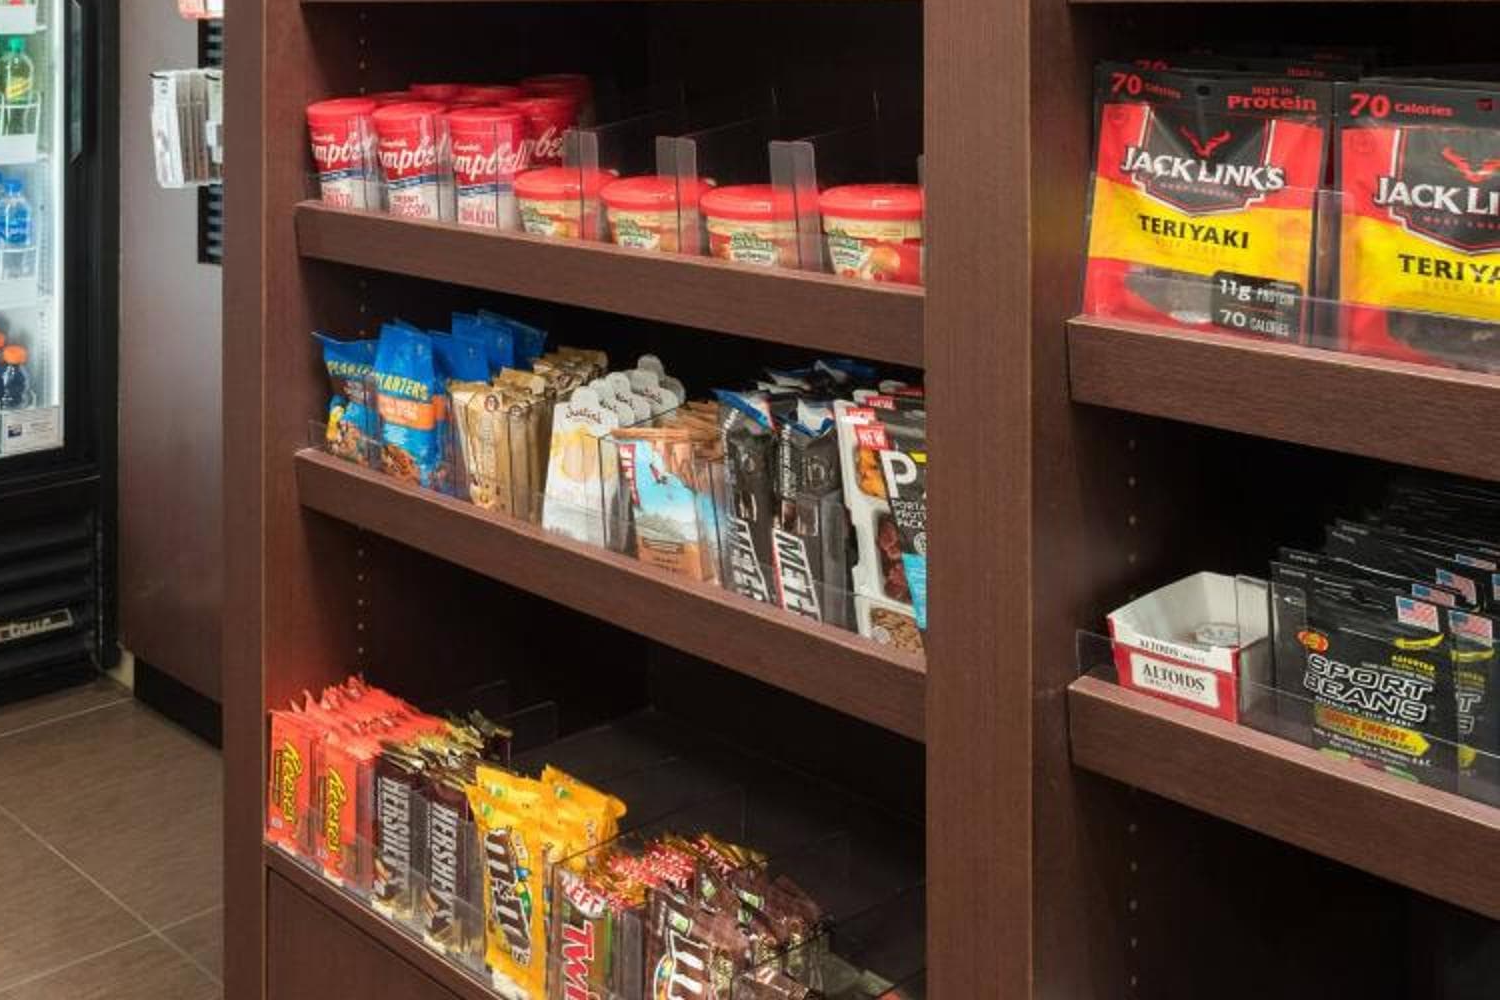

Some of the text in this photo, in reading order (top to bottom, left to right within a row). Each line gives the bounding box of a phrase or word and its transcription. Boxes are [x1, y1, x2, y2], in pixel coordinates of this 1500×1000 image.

[1110, 72, 1142, 95] 70
[1227, 95, 1317, 111] Protein
[1350, 92, 1390, 118] 70
[454, 141, 528, 180] mpbell
[1121, 147, 1196, 182] JACK
[1198, 161, 1285, 191] LINK'S
[1374, 177, 1463, 215] JACK
[1138, 215, 1250, 249] TERIYAKI
[1219, 280, 1296, 306] 11g PROTEIN
[1220, 309, 1289, 336] 70 CALORIES
[857, 428, 886, 449] NEW
[1144, 664, 1205, 691] ALTOIDS
[1308, 653, 1432, 700] SPORT
[1304, 672, 1427, 722] BEANS
